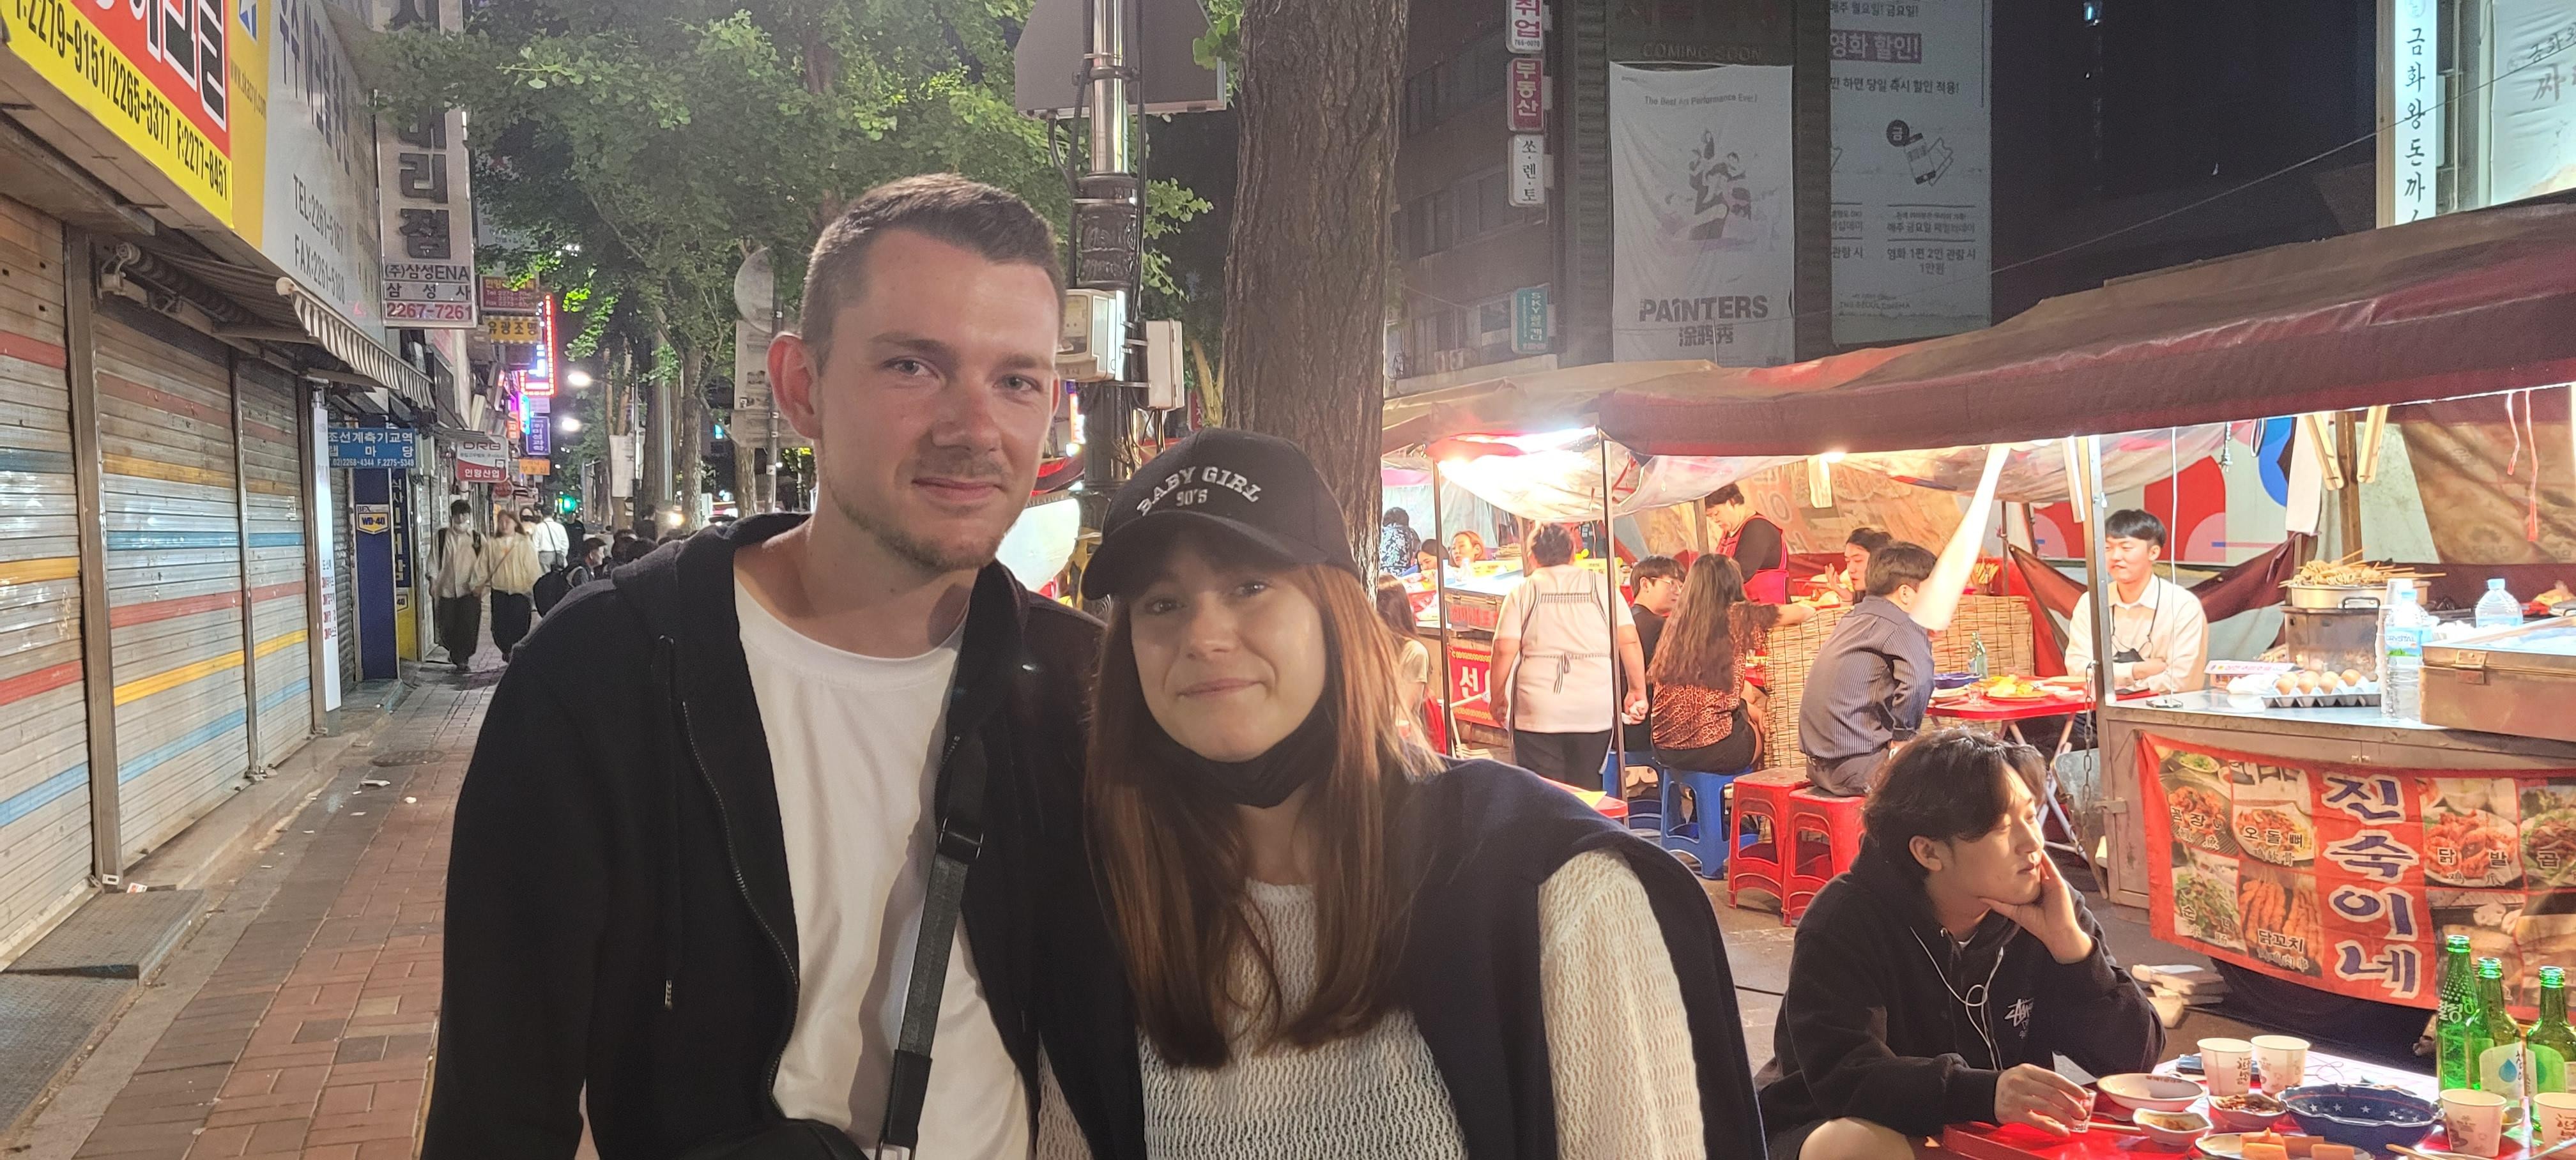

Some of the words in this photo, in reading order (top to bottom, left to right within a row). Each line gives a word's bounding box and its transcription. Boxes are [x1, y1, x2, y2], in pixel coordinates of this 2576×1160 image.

[1830, 33, 1868, 58] 영화
[1874, 34, 1919, 60] 할인!
[1516, 62, 1538, 116] 부동산
[2404, 27, 2426, 222] 금화왕돈까
[177, 118, 227, 201] F:2277-8451
[385, 264, 470, 280] (주)삼성ENA
[387, 303, 471, 320] 2267-7261
[463, 441, 502, 451] DRB
[1137, 466, 1197, 516] BABY
[1202, 467, 1262, 503] GIRL
[2326, 775, 2419, 995] 진숙이네
[2258, 929, 2304, 952] 닭꼬치
